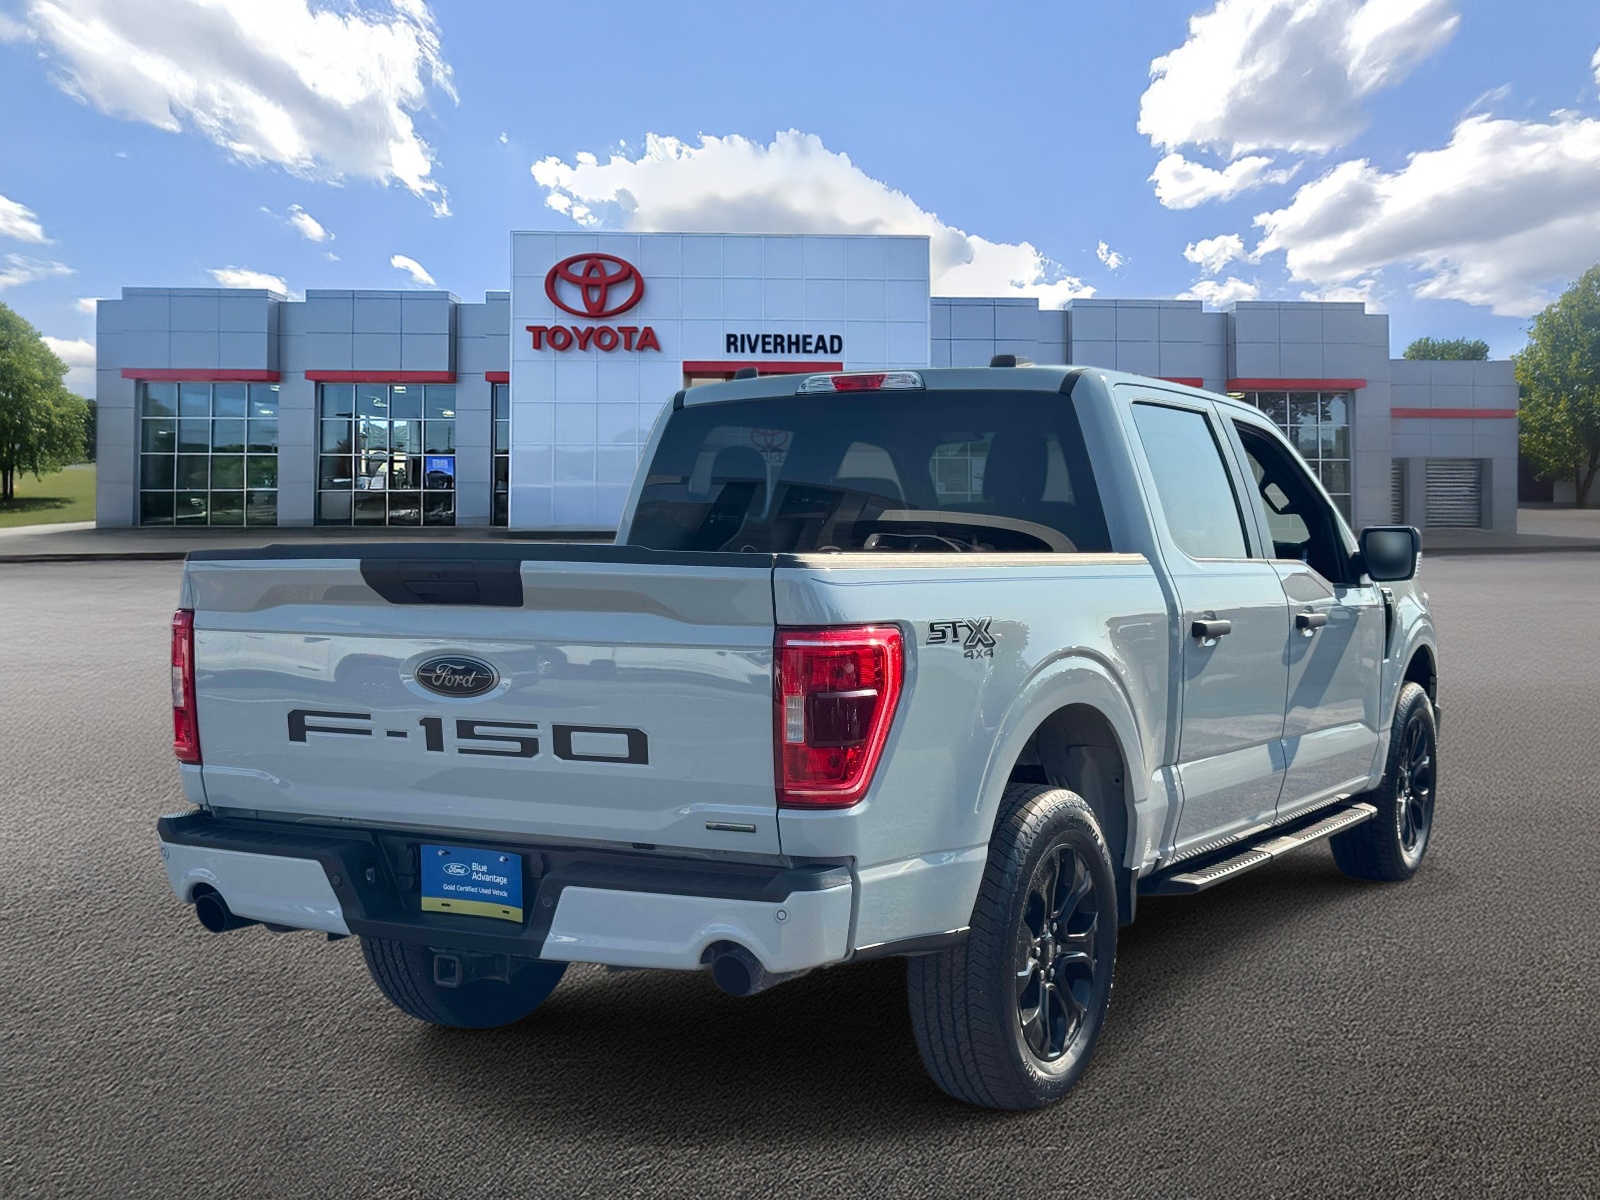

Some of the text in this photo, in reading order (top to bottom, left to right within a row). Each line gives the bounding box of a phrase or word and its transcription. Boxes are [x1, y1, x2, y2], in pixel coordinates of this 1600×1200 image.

[526, 325, 660, 351] TOYOTA
[726, 333, 843, 354] RIVERHEAD
[926, 616, 996, 650] STX
[432, 664, 477, 688] Ford
[287, 709, 650, 765] F-150
[448, 864, 466, 874] Ford
[472, 862, 487, 872] Blue
[472, 872, 507, 885] Advantage
[442, 883, 508, 897] Gold Certified Used Vehicle
